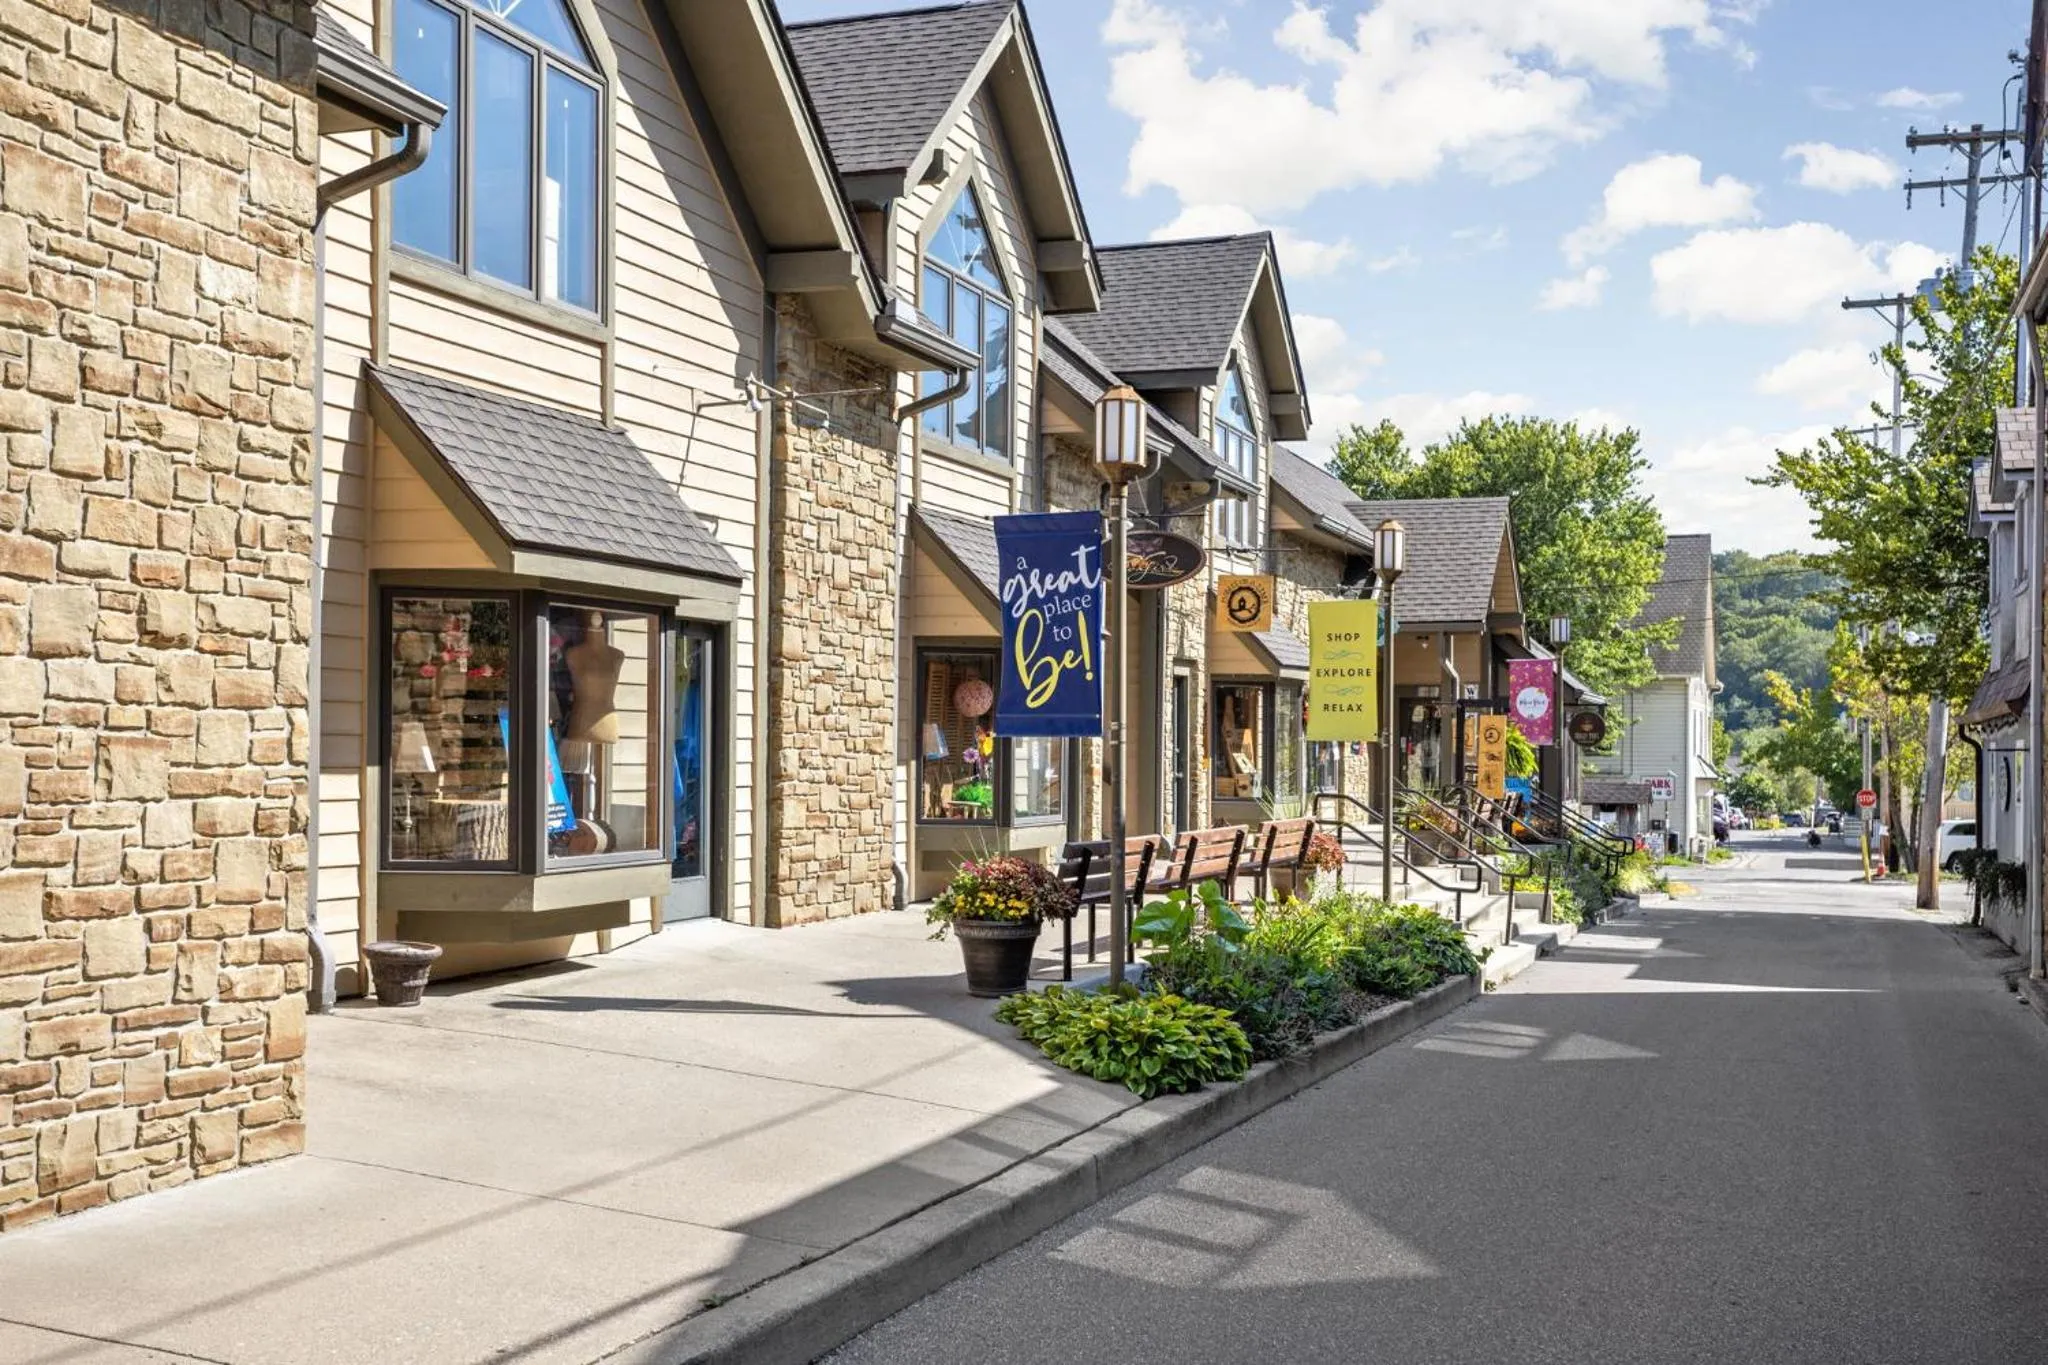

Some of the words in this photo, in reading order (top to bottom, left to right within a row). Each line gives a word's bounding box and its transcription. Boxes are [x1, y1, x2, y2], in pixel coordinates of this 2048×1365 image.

[1016, 556, 1028, 570] a
[1002, 545, 1101, 618] great
[1044, 594, 1092, 624] place
[1052, 625, 1072, 642] to
[1326, 632, 1360, 642] SHOP
[1316, 668, 1372, 678] EXPLORE
[1323, 703, 1363, 713] RELAX
[1859, 795, 1876, 803] STOP
